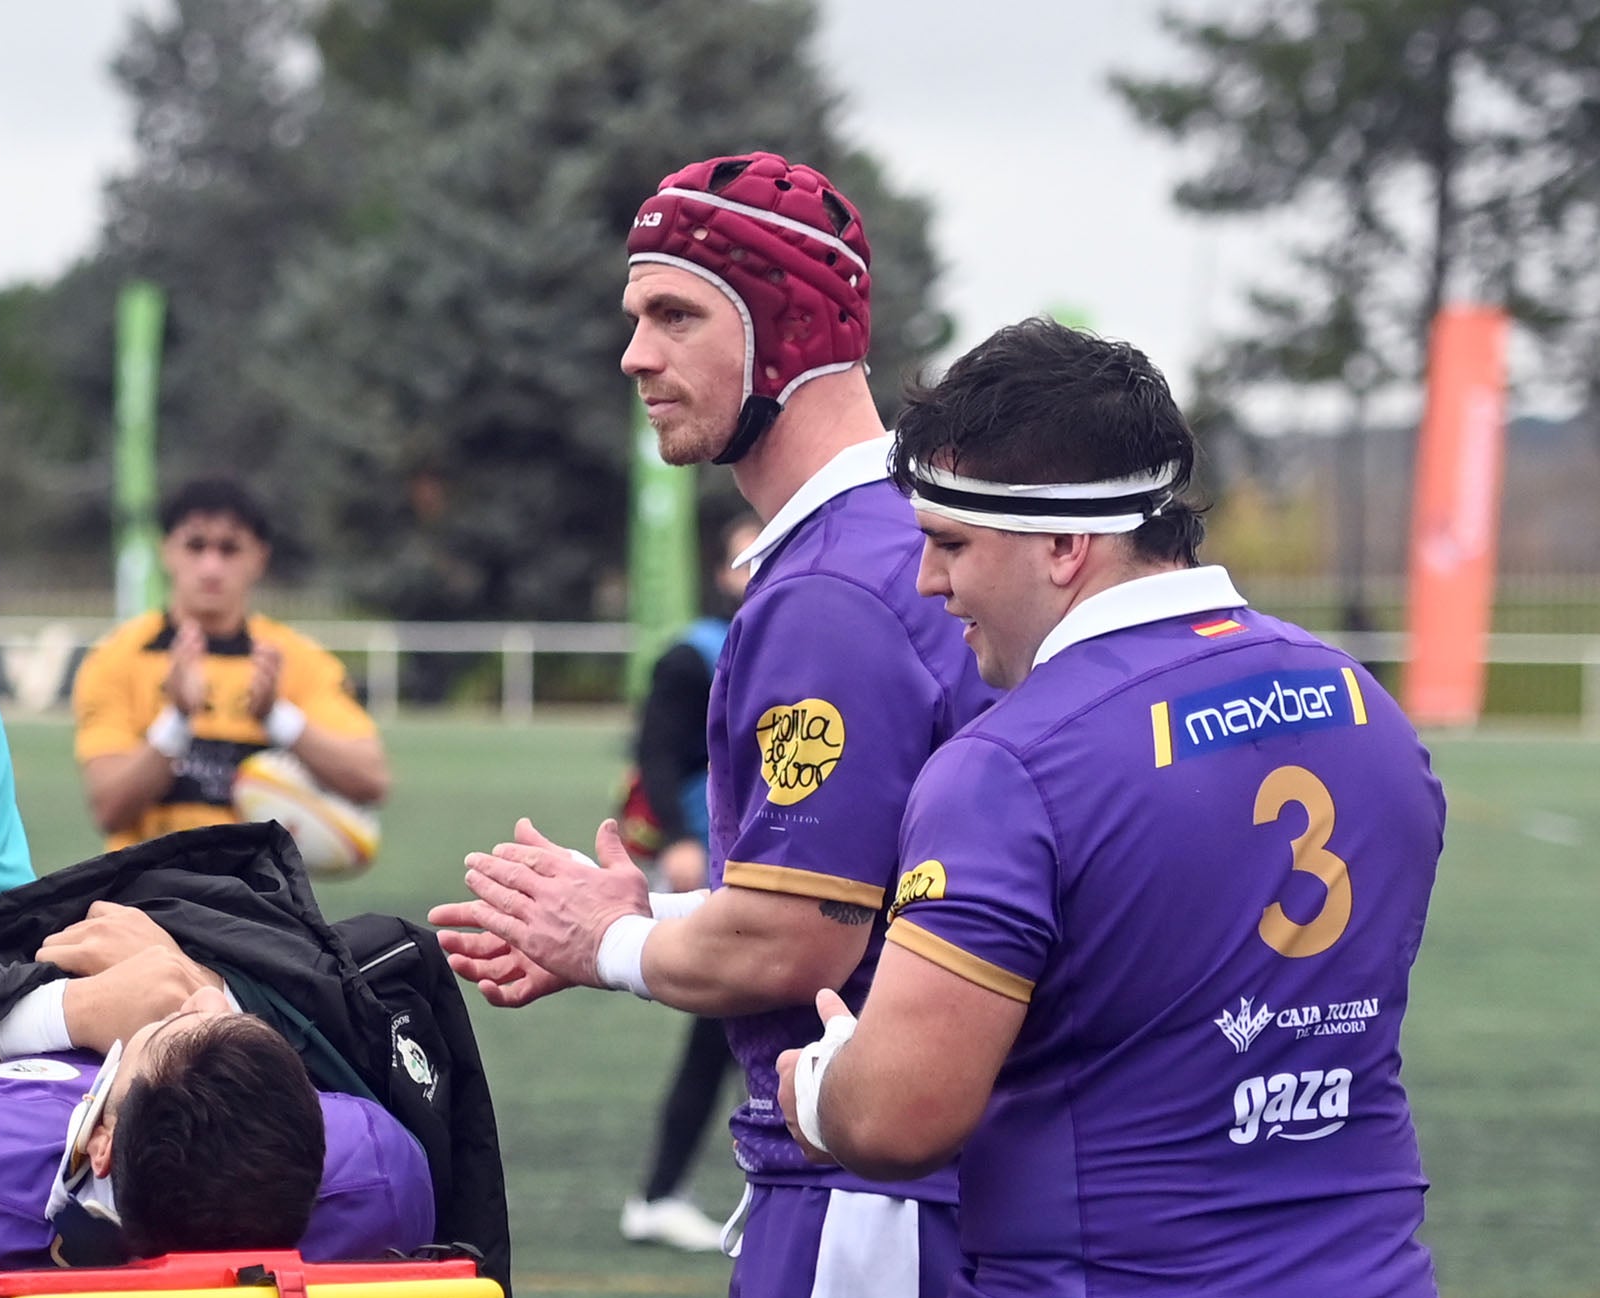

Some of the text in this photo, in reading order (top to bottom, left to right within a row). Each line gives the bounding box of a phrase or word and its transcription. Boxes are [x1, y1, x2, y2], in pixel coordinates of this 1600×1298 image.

[1184, 680, 1337, 745] maxber
[1253, 764, 1354, 958] 3
[1276, 998, 1380, 1028] CAJA RURAL
[1295, 1020, 1366, 1040] DE ZAMORA
[1228, 1067, 1353, 1145] gaza
